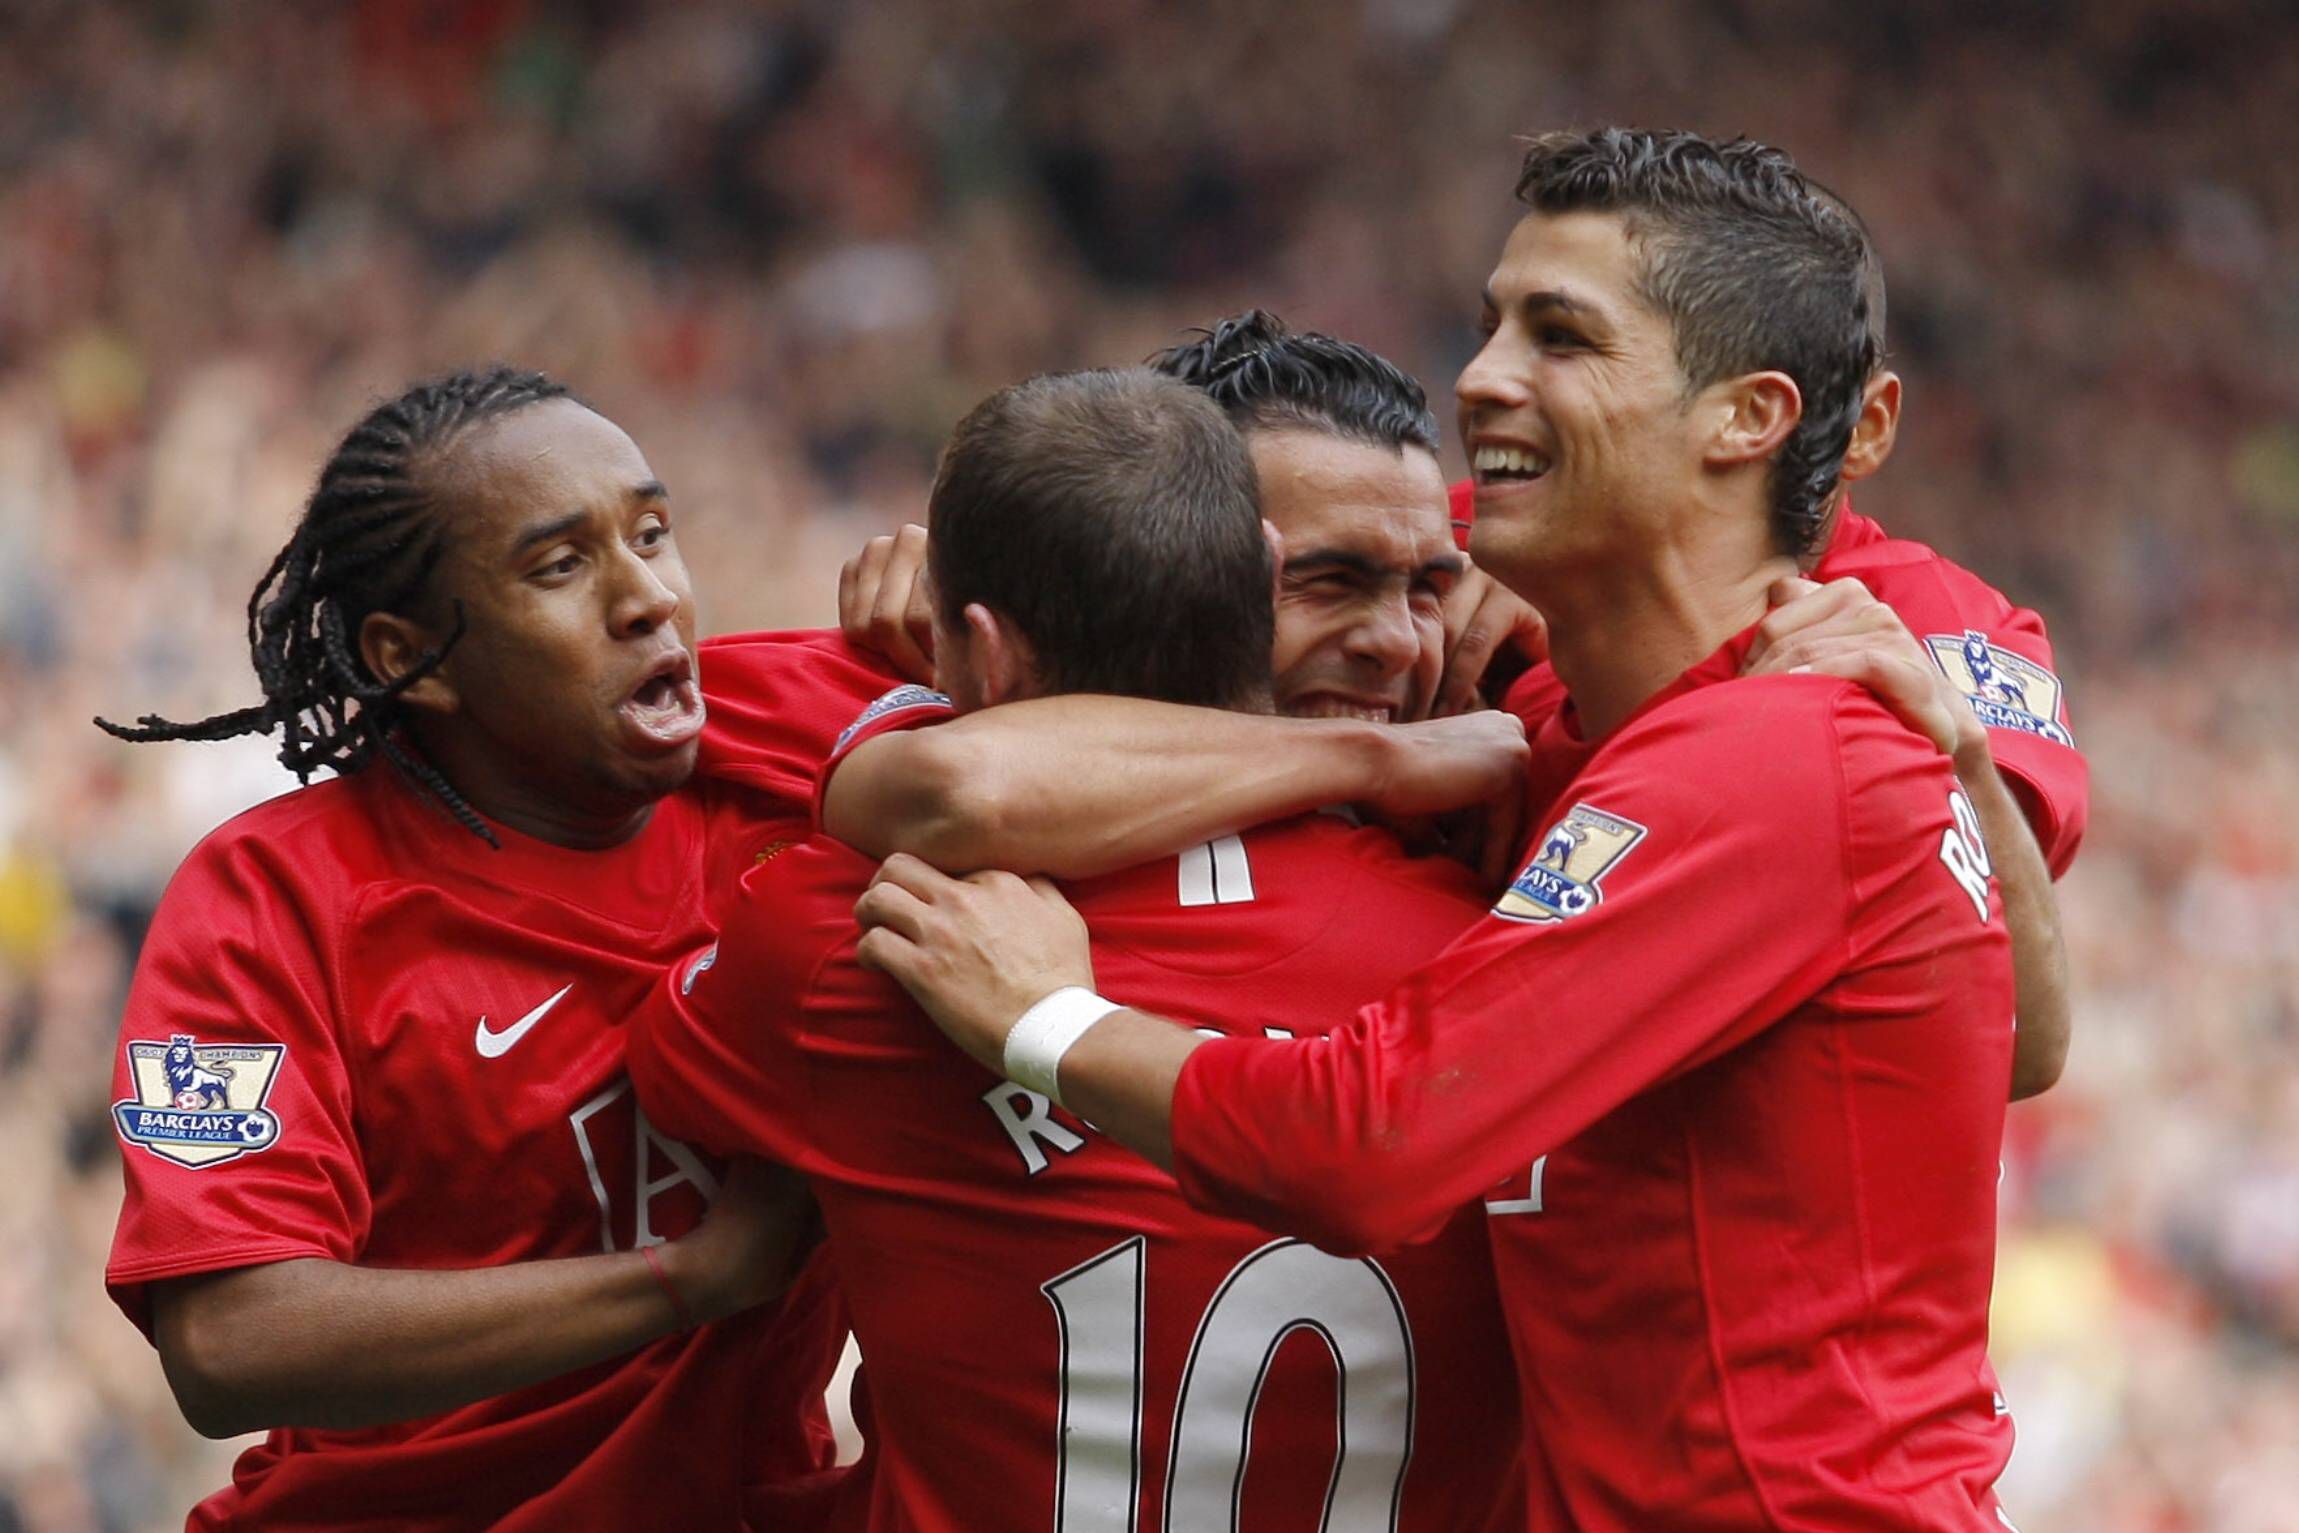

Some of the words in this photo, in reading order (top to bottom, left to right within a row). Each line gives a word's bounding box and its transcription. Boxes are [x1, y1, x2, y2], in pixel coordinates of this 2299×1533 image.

[138, 1112, 234, 1132] BARCLAYS
[137, 1126, 187, 1138] PREMIER
[188, 1131, 232, 1140] LEAGUE
[1040, 1236, 1416, 1533] 10
